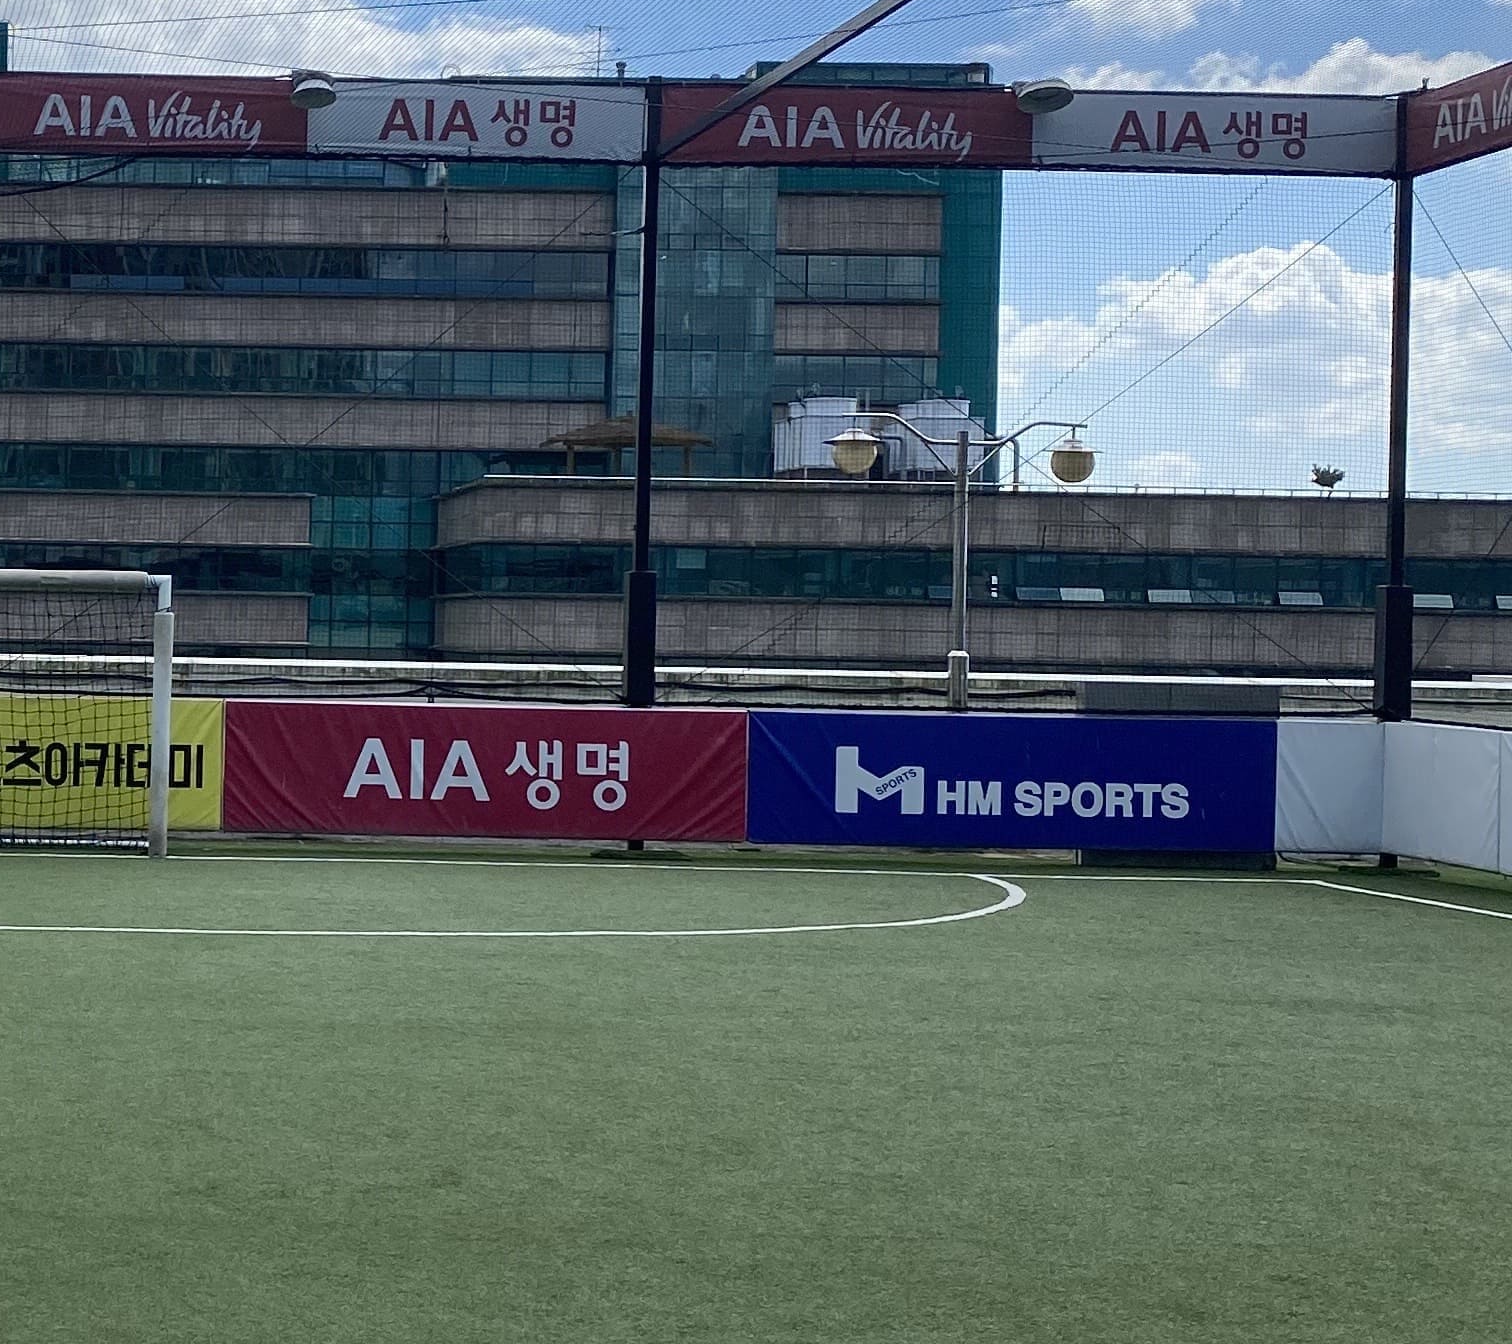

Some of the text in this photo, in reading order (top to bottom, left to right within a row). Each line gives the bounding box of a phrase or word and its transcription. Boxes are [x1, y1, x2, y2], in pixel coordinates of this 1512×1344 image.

[33, 91, 262, 151] AIA Vitality
[379, 98, 577, 148] AIA 생명
[738, 101, 973, 160] AIA Vitality
[1110, 110, 1309, 160] AIA 생명
[1433, 92, 1487, 149] AIA
[343, 737, 630, 812] AIA 생명
[875, 768, 917, 796] SPORTS
[937, 780, 1190, 820] HM SPORTS
